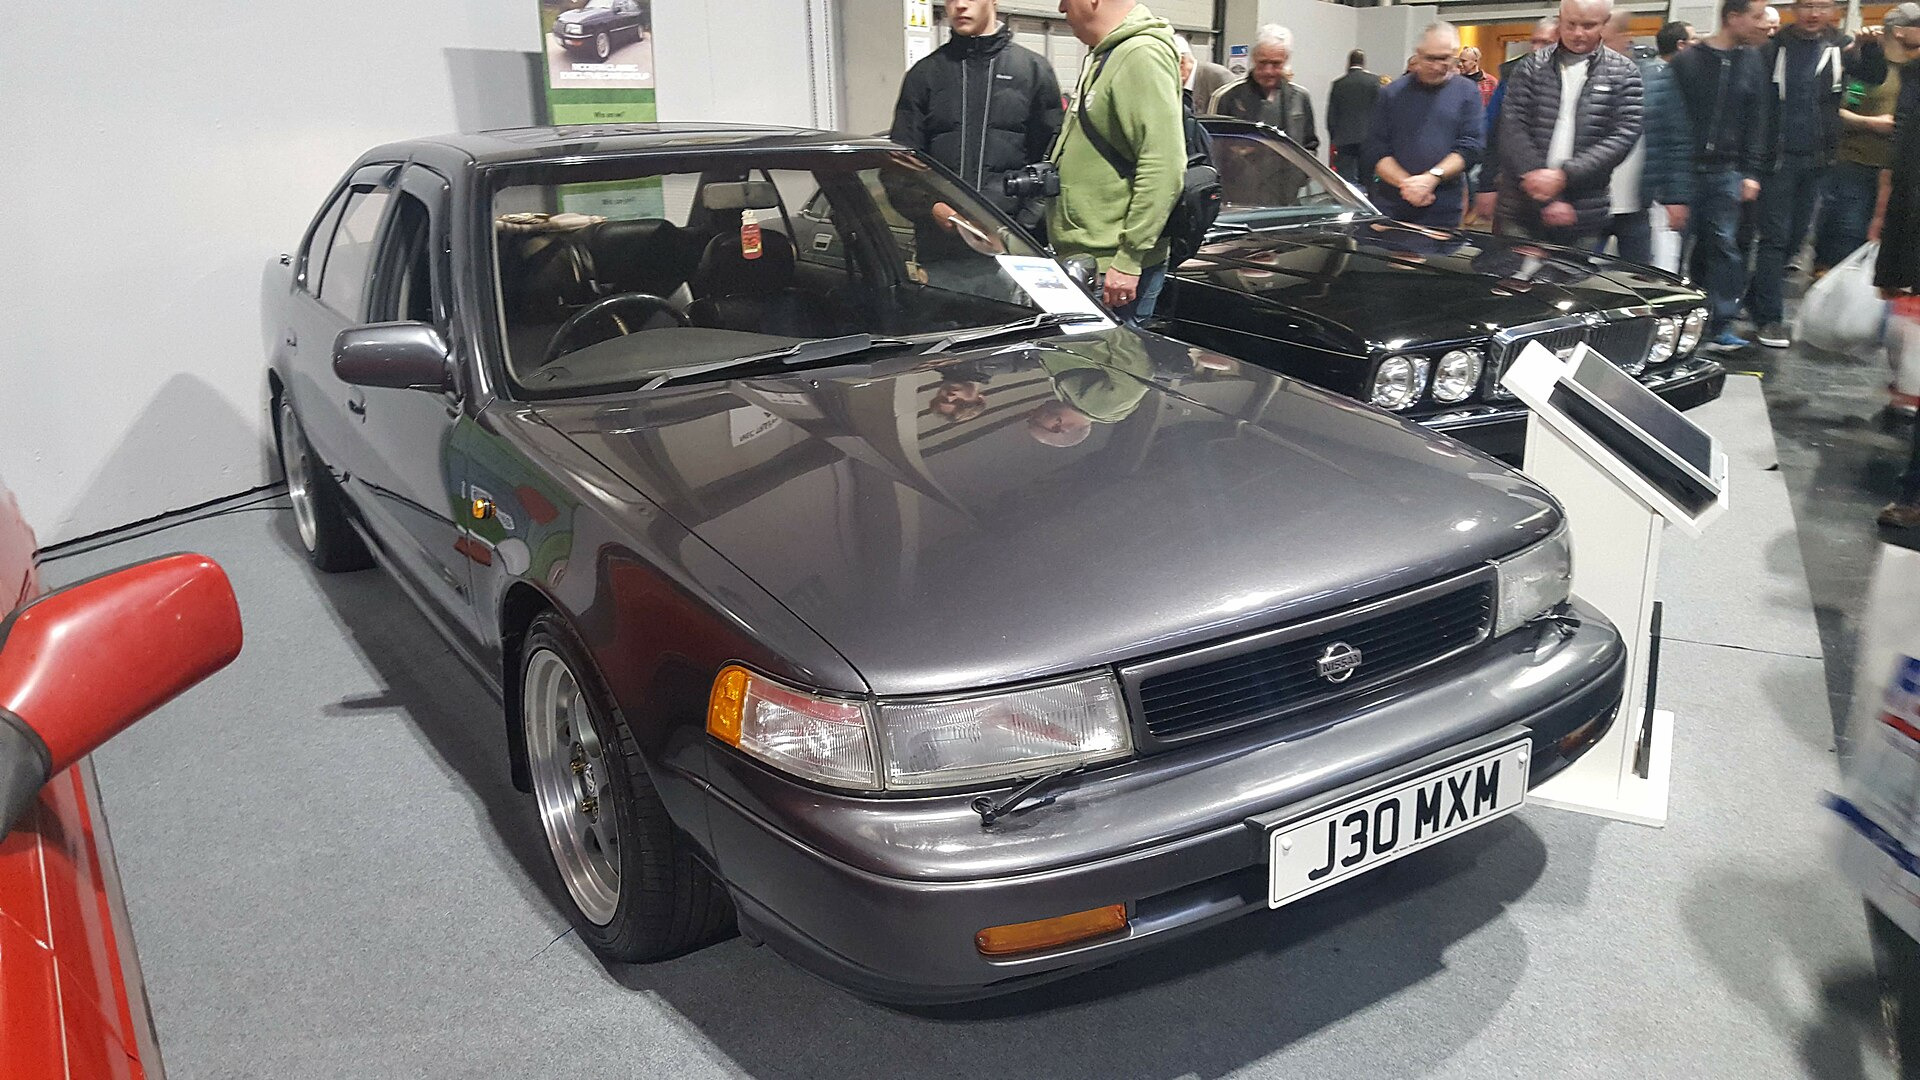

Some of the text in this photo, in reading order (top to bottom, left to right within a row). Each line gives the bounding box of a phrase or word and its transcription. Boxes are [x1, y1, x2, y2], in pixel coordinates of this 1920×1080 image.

[1322, 653, 1361, 673] NISSAN
[1308, 759, 1501, 881] J30 MXM
